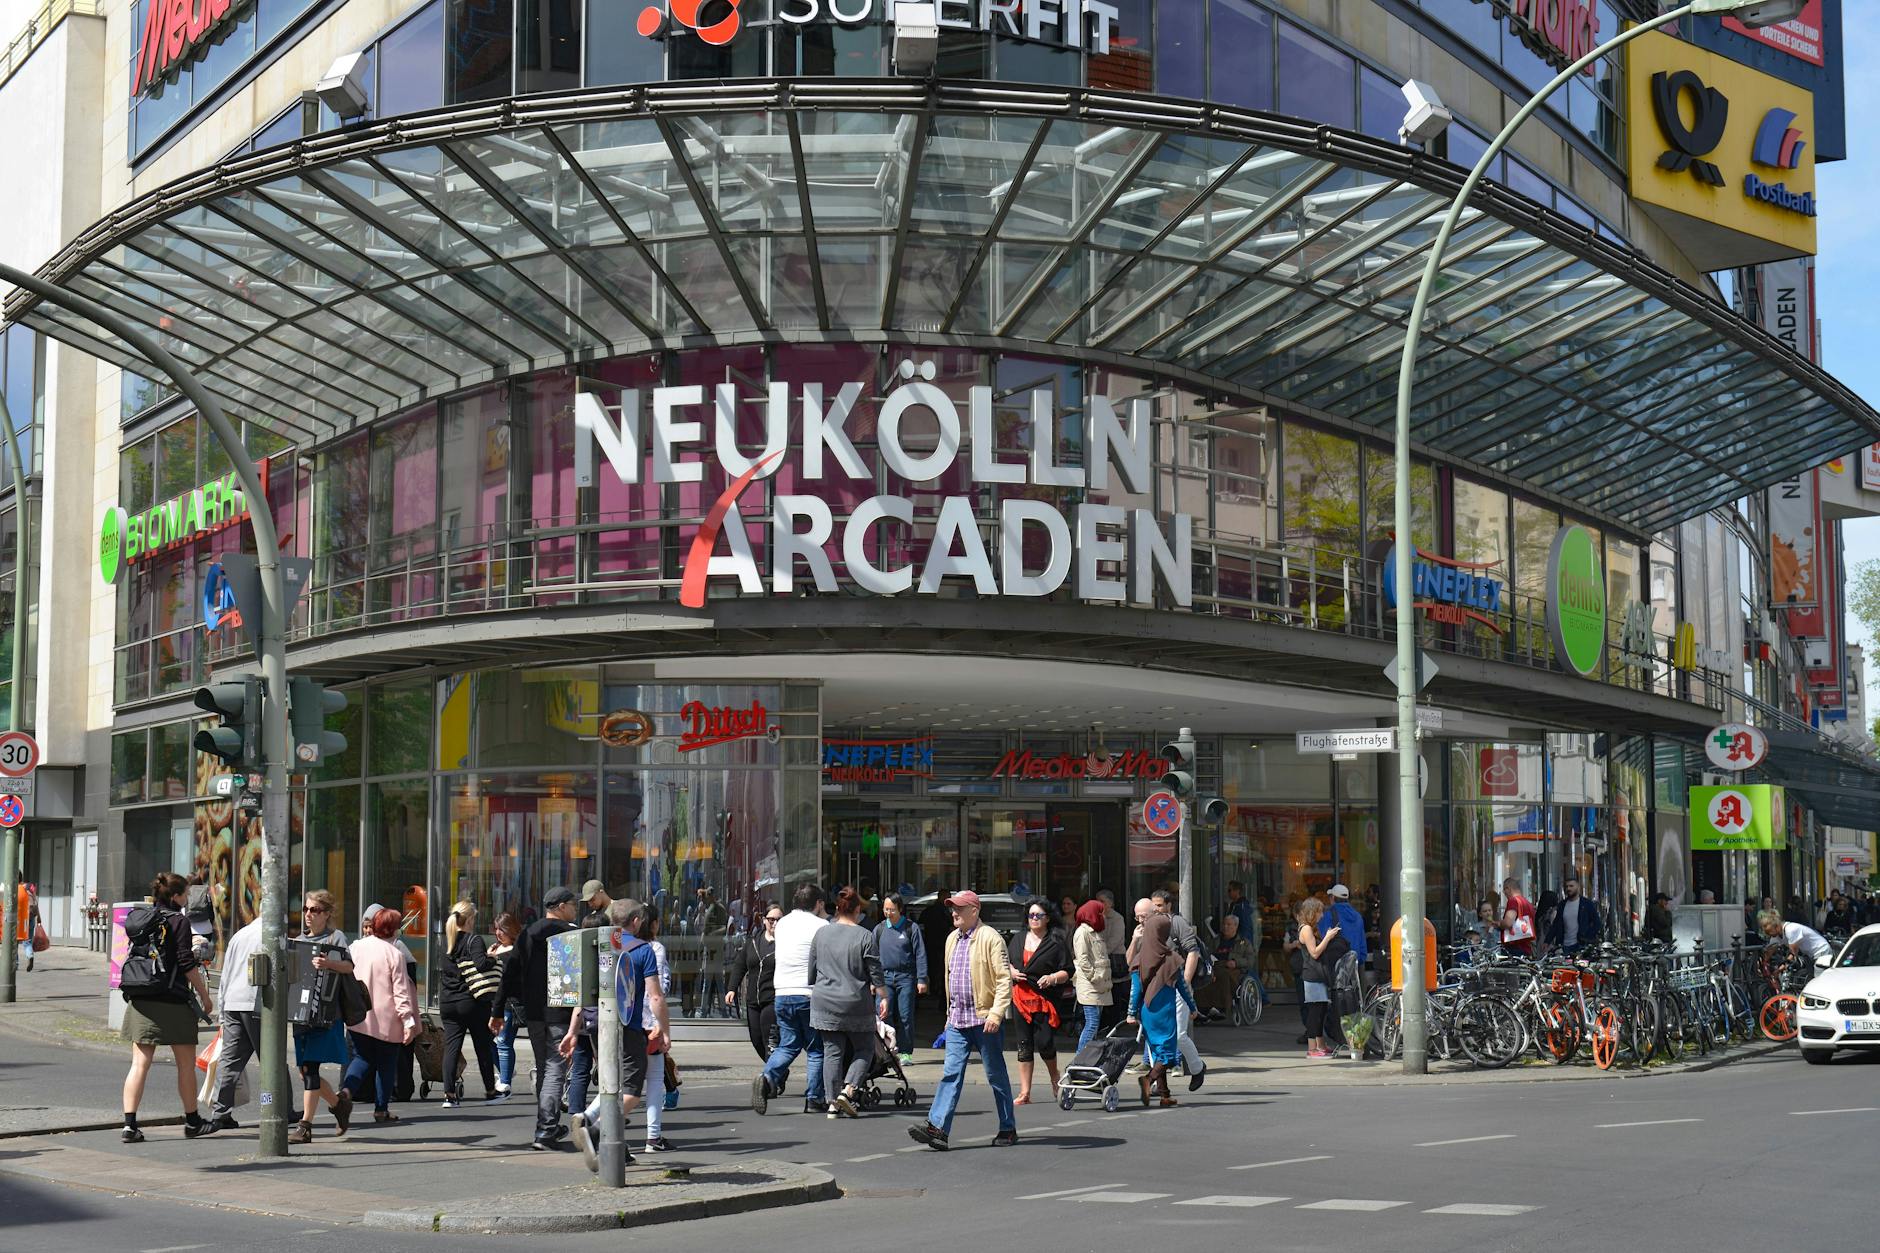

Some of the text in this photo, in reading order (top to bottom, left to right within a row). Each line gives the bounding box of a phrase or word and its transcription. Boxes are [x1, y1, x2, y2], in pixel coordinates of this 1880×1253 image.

[1745, 173, 1817, 217] Postbank
[575, 359, 1151, 494] NEUKÖLLN
[681, 449, 1193, 608] ARCADEN
[680, 699, 767, 743] Ditsch
[2, 744, 29, 765] 30
[822, 745, 936, 768] NEPLEX
[1303, 734, 1388, 749] Flughafenstraße
[992, 749, 1170, 779] Media Mar
